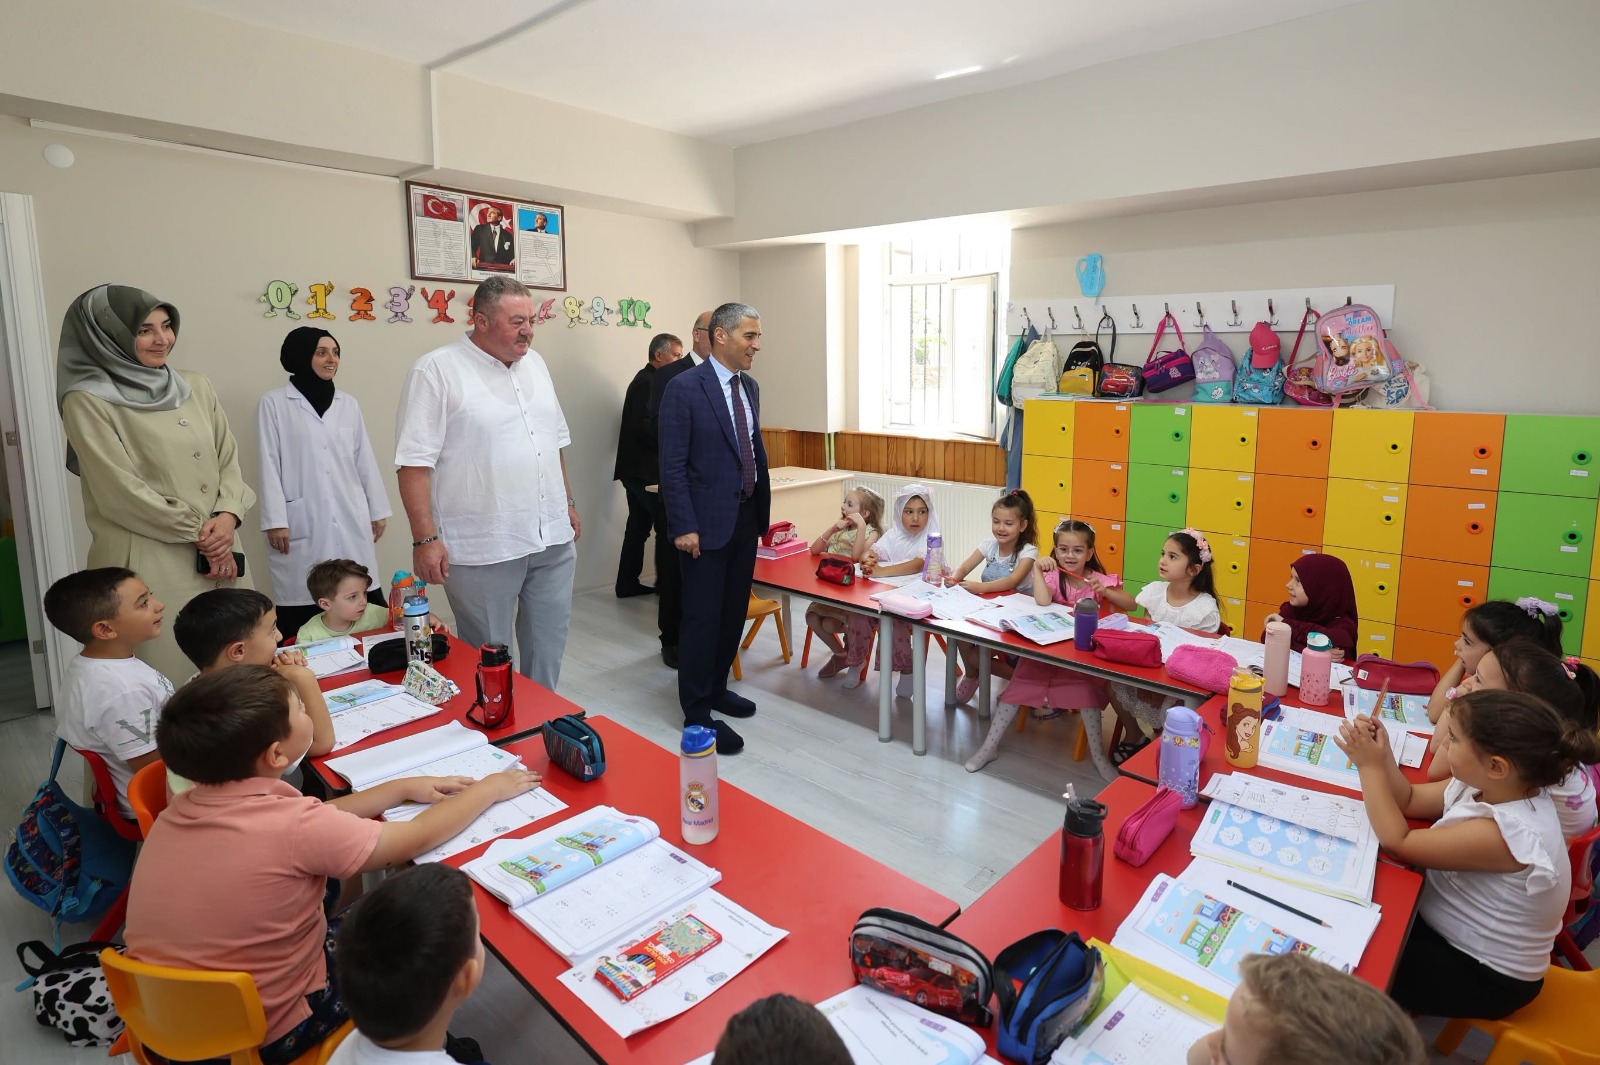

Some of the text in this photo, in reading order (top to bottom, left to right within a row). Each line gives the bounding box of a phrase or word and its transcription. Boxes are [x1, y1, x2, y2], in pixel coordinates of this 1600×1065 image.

[268, 280, 292, 309] 0
[309, 284, 326, 310] 1
[350, 288, 373, 311] 2
[389, 287, 409, 313] 3
[427, 290, 448, 315] 4
[564, 296, 580, 319] 8
[620, 299, 646, 321] 10
[1329, 363, 1358, 380] Barbie
[693, 817, 713, 826] Madrid
